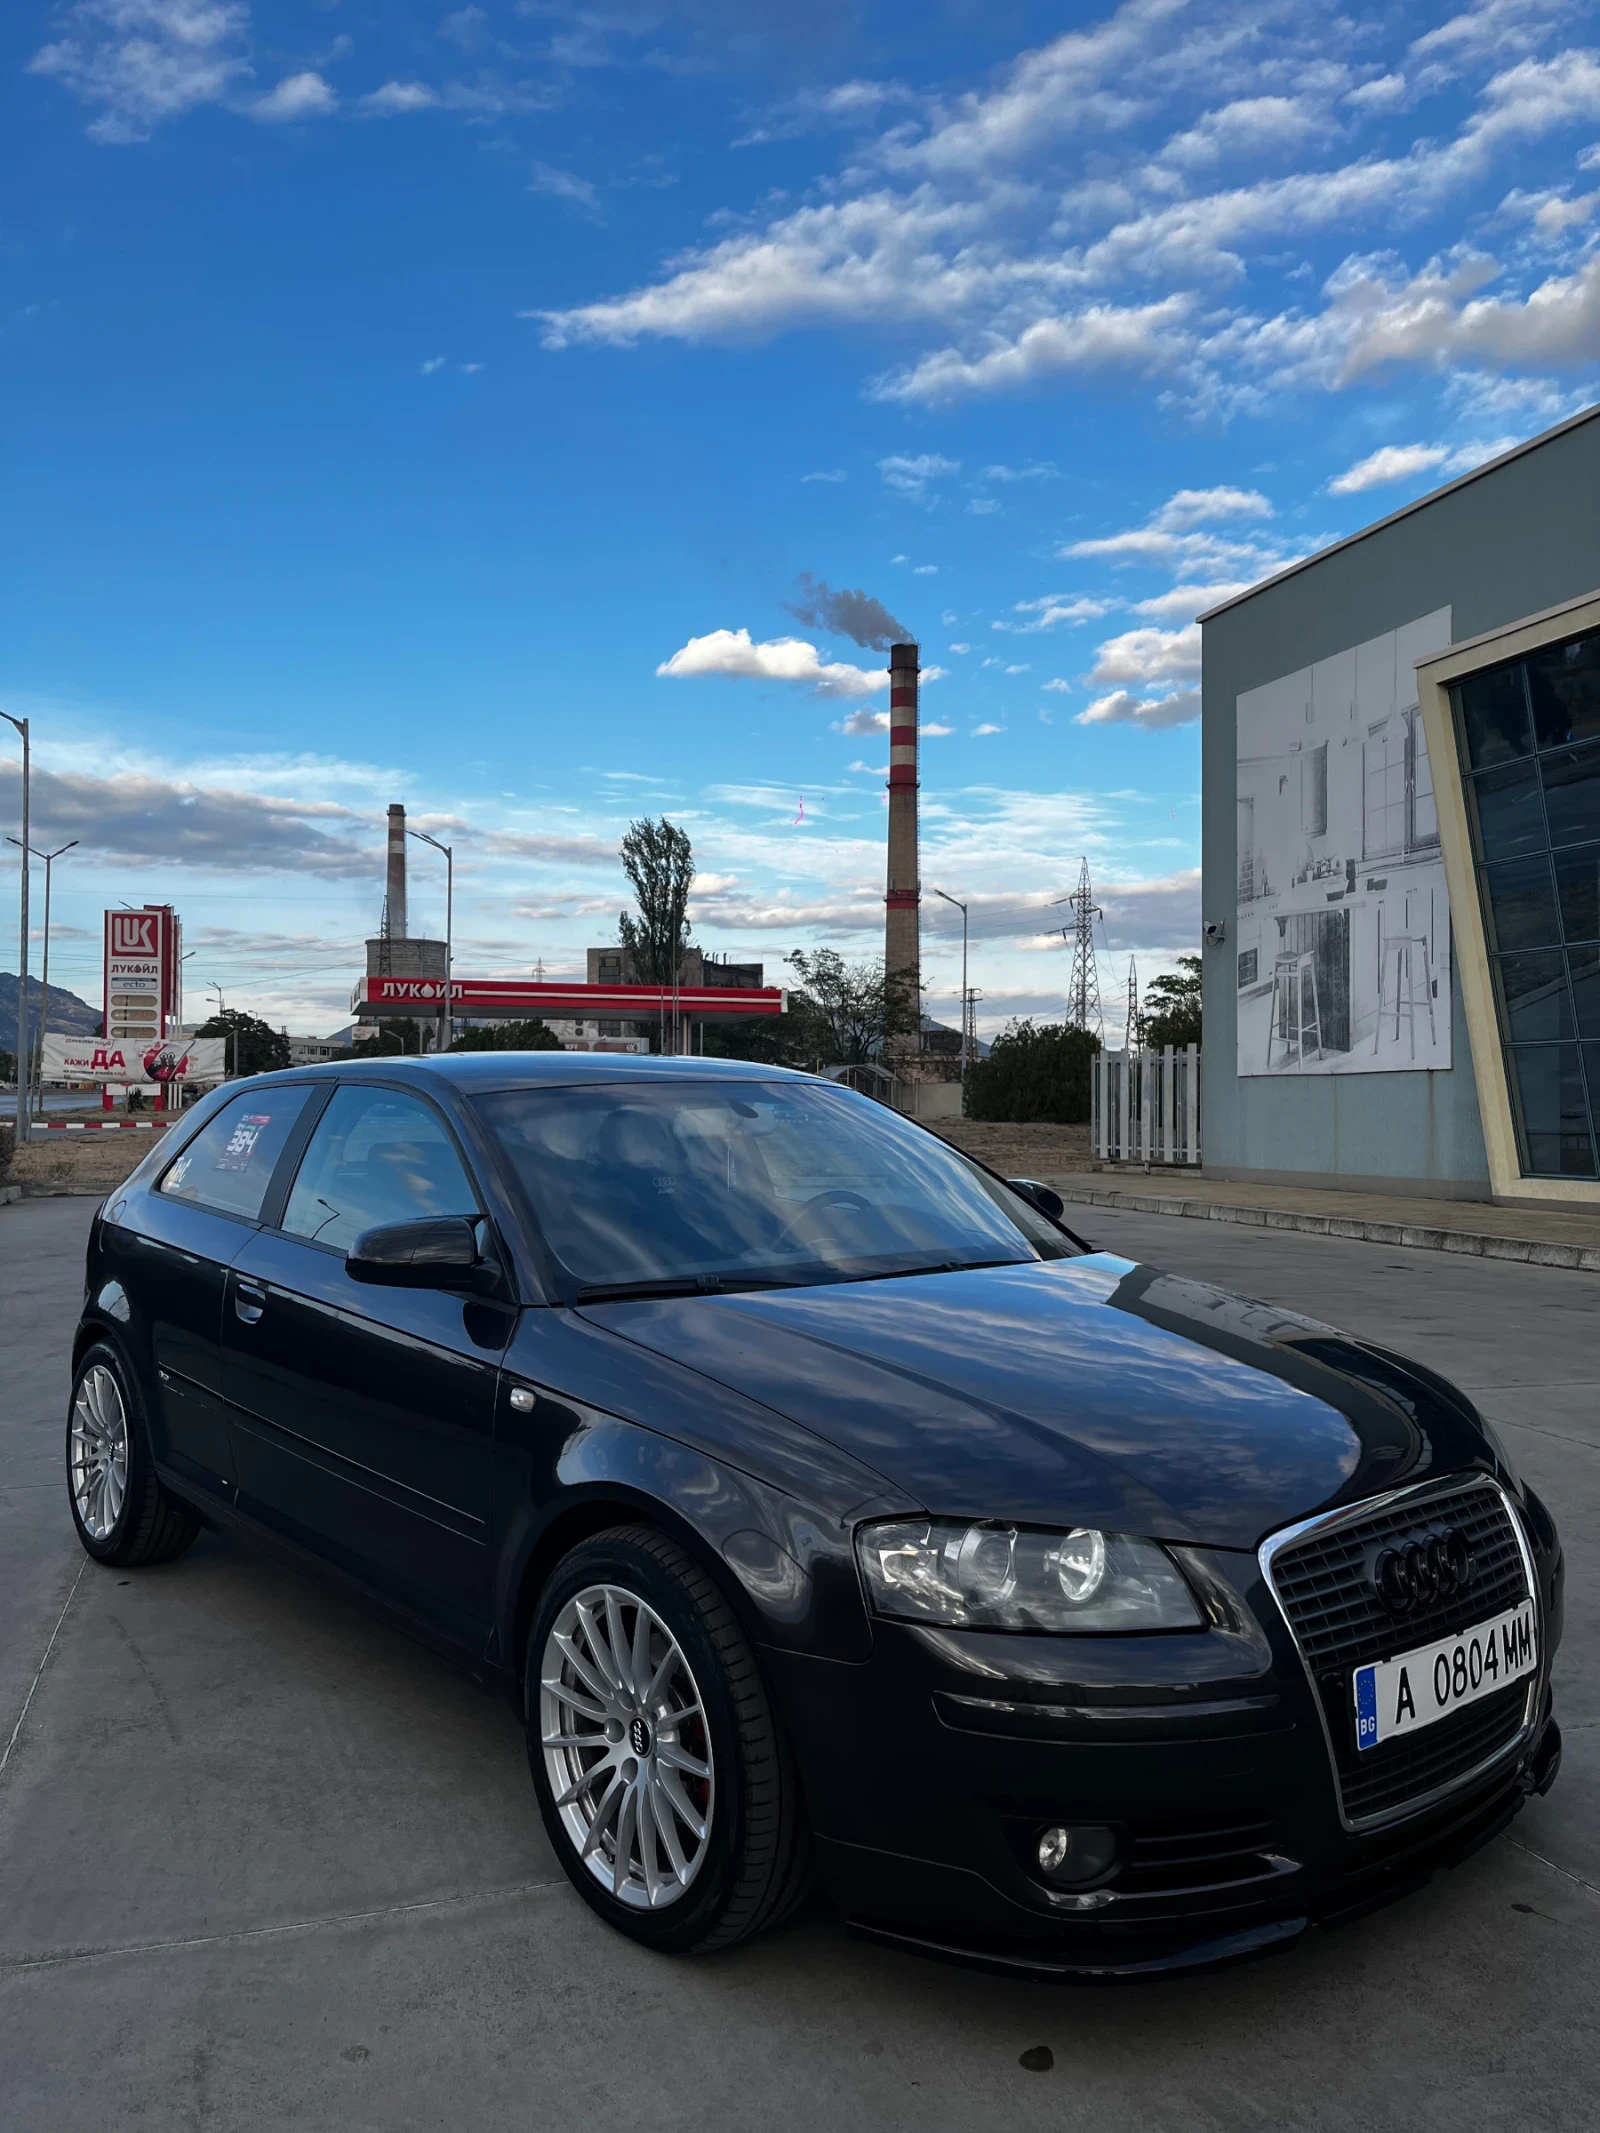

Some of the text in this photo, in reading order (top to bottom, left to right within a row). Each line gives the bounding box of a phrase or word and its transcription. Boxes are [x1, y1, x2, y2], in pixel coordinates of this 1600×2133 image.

[64, 1049, 126, 1070] КАЖИ ДА
[226, 1130, 259, 1153] 384
[1395, 1666, 1416, 1724] A
[1433, 1628, 1499, 1706] 0804
[1360, 1716, 1376, 1736] BG
